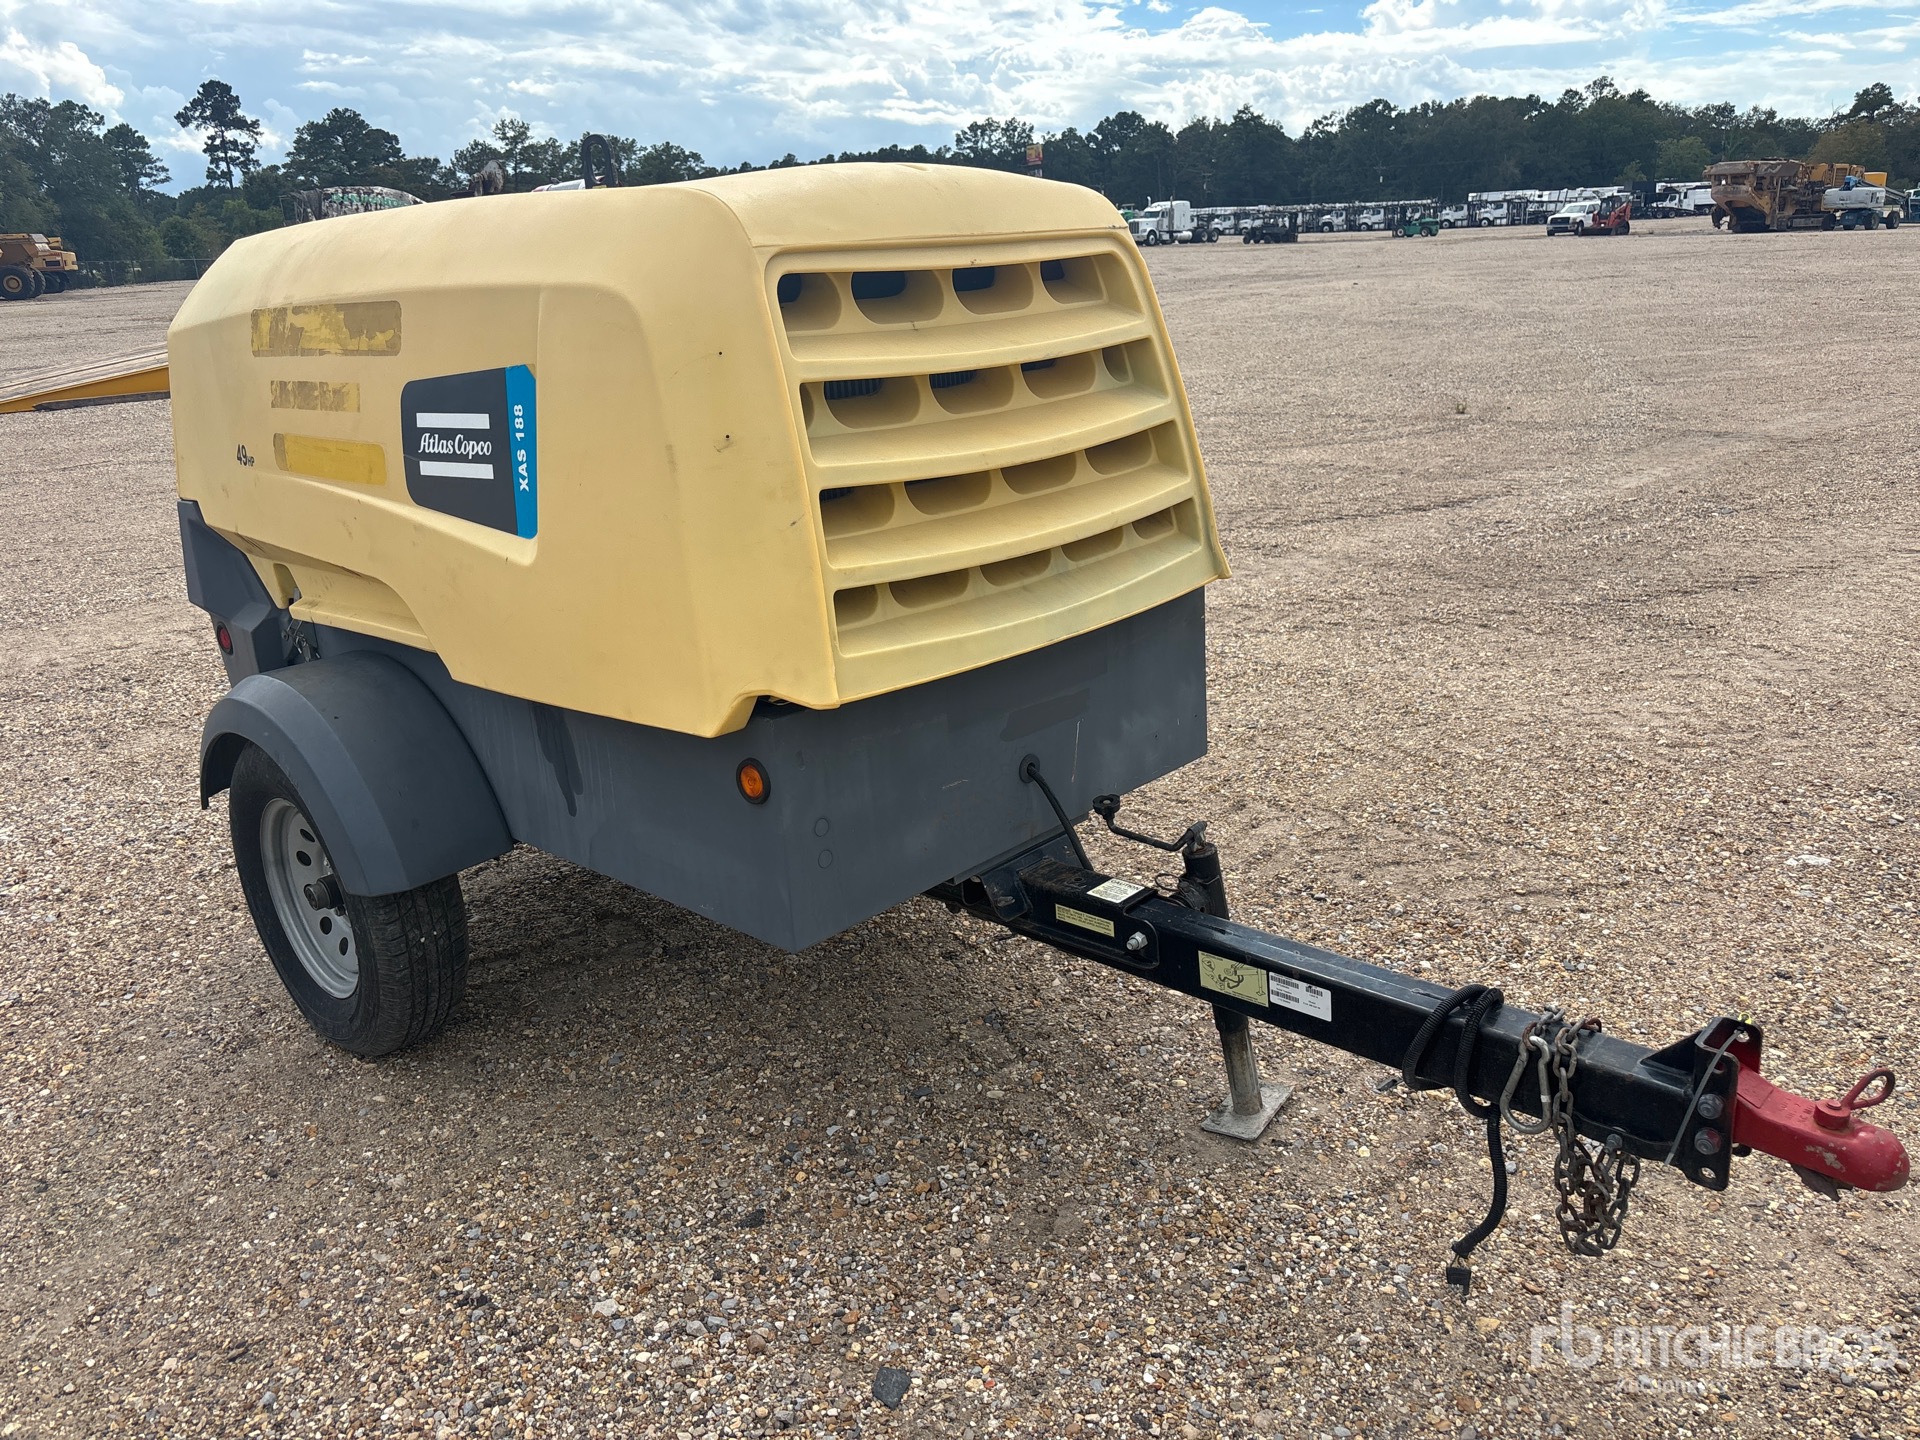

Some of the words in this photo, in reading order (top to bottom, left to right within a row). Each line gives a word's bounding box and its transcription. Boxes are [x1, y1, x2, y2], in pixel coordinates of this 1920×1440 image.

[513, 404, 525, 441] 188
[418, 432, 453, 454] Atlas
[455, 434, 492, 460] Copco
[517, 449, 529, 492] XAS
